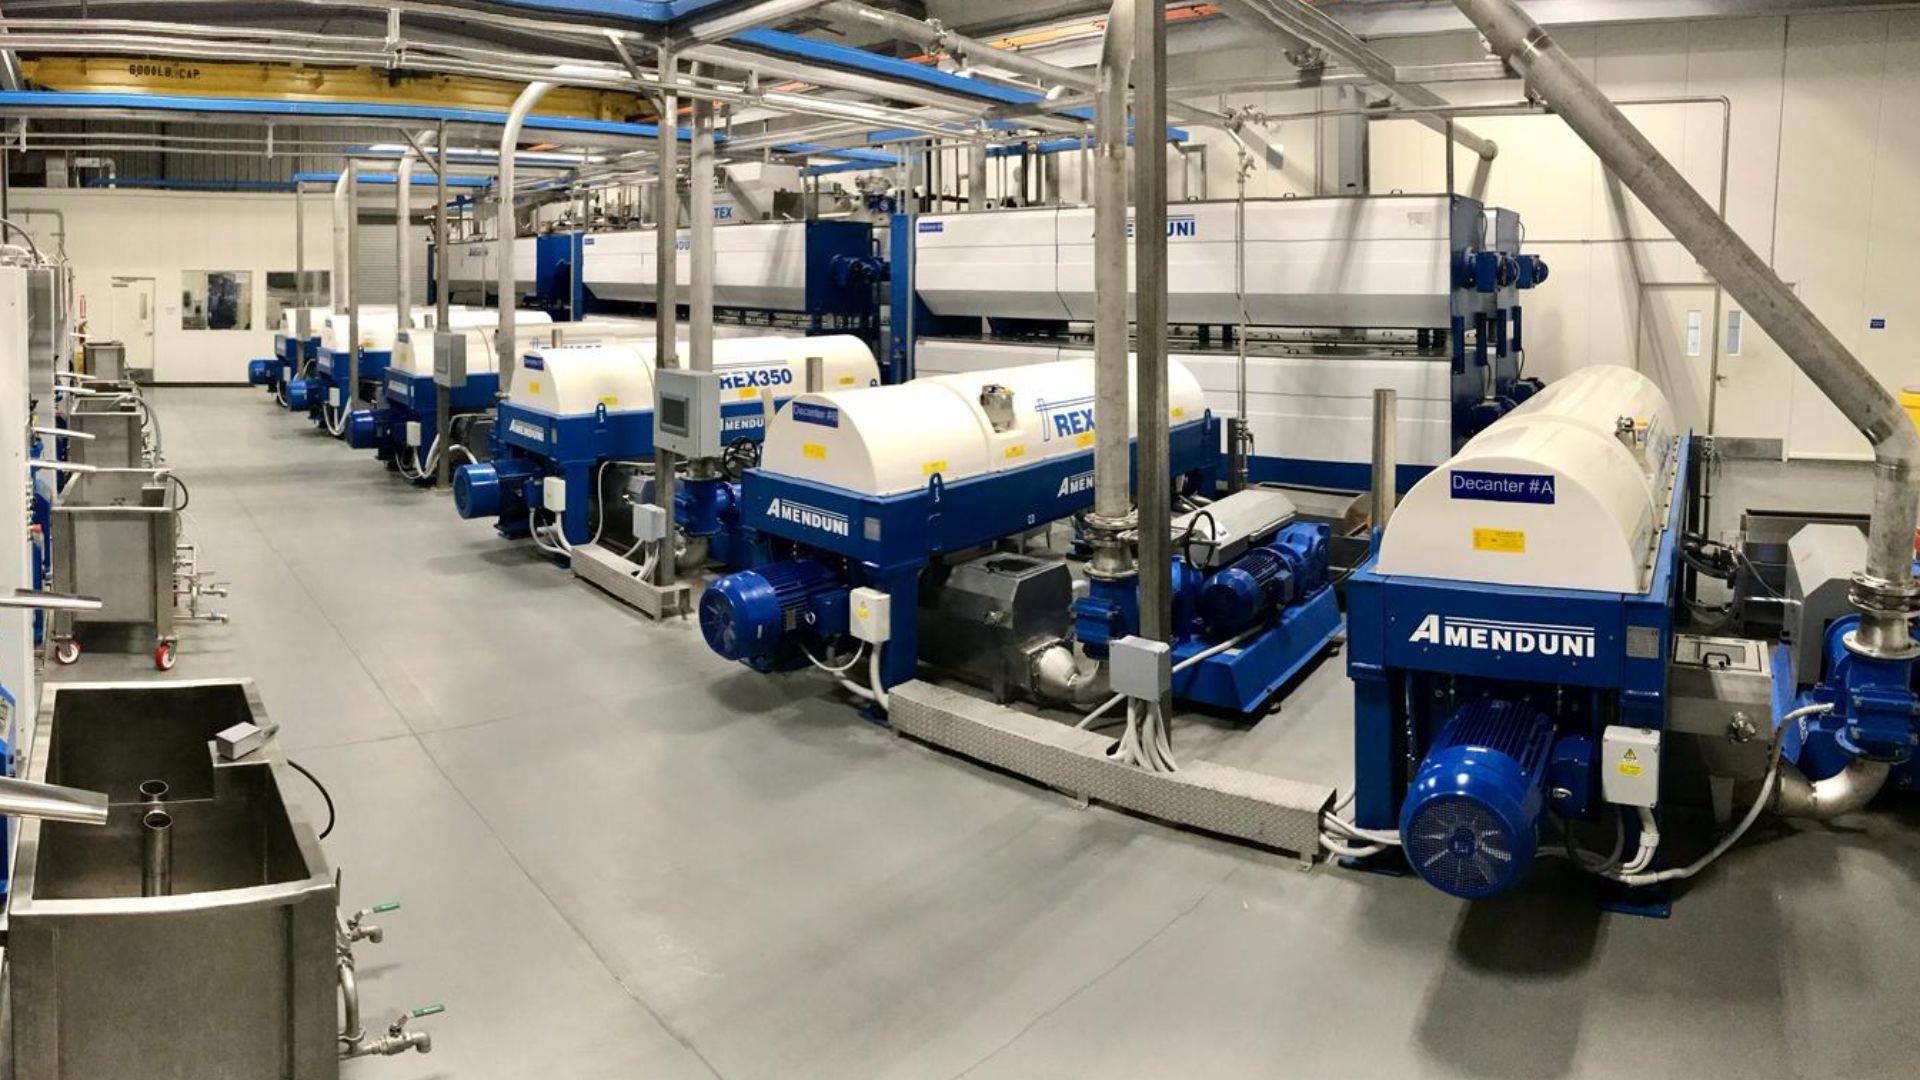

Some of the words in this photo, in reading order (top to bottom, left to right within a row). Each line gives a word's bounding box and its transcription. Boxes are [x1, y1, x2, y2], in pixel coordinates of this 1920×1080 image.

[1452, 474, 1525, 494] Decanter
[1528, 478, 1554, 495] #A
[765, 497, 849, 537] AMENDUNI
[1408, 613, 1596, 659] AMENDUNI
